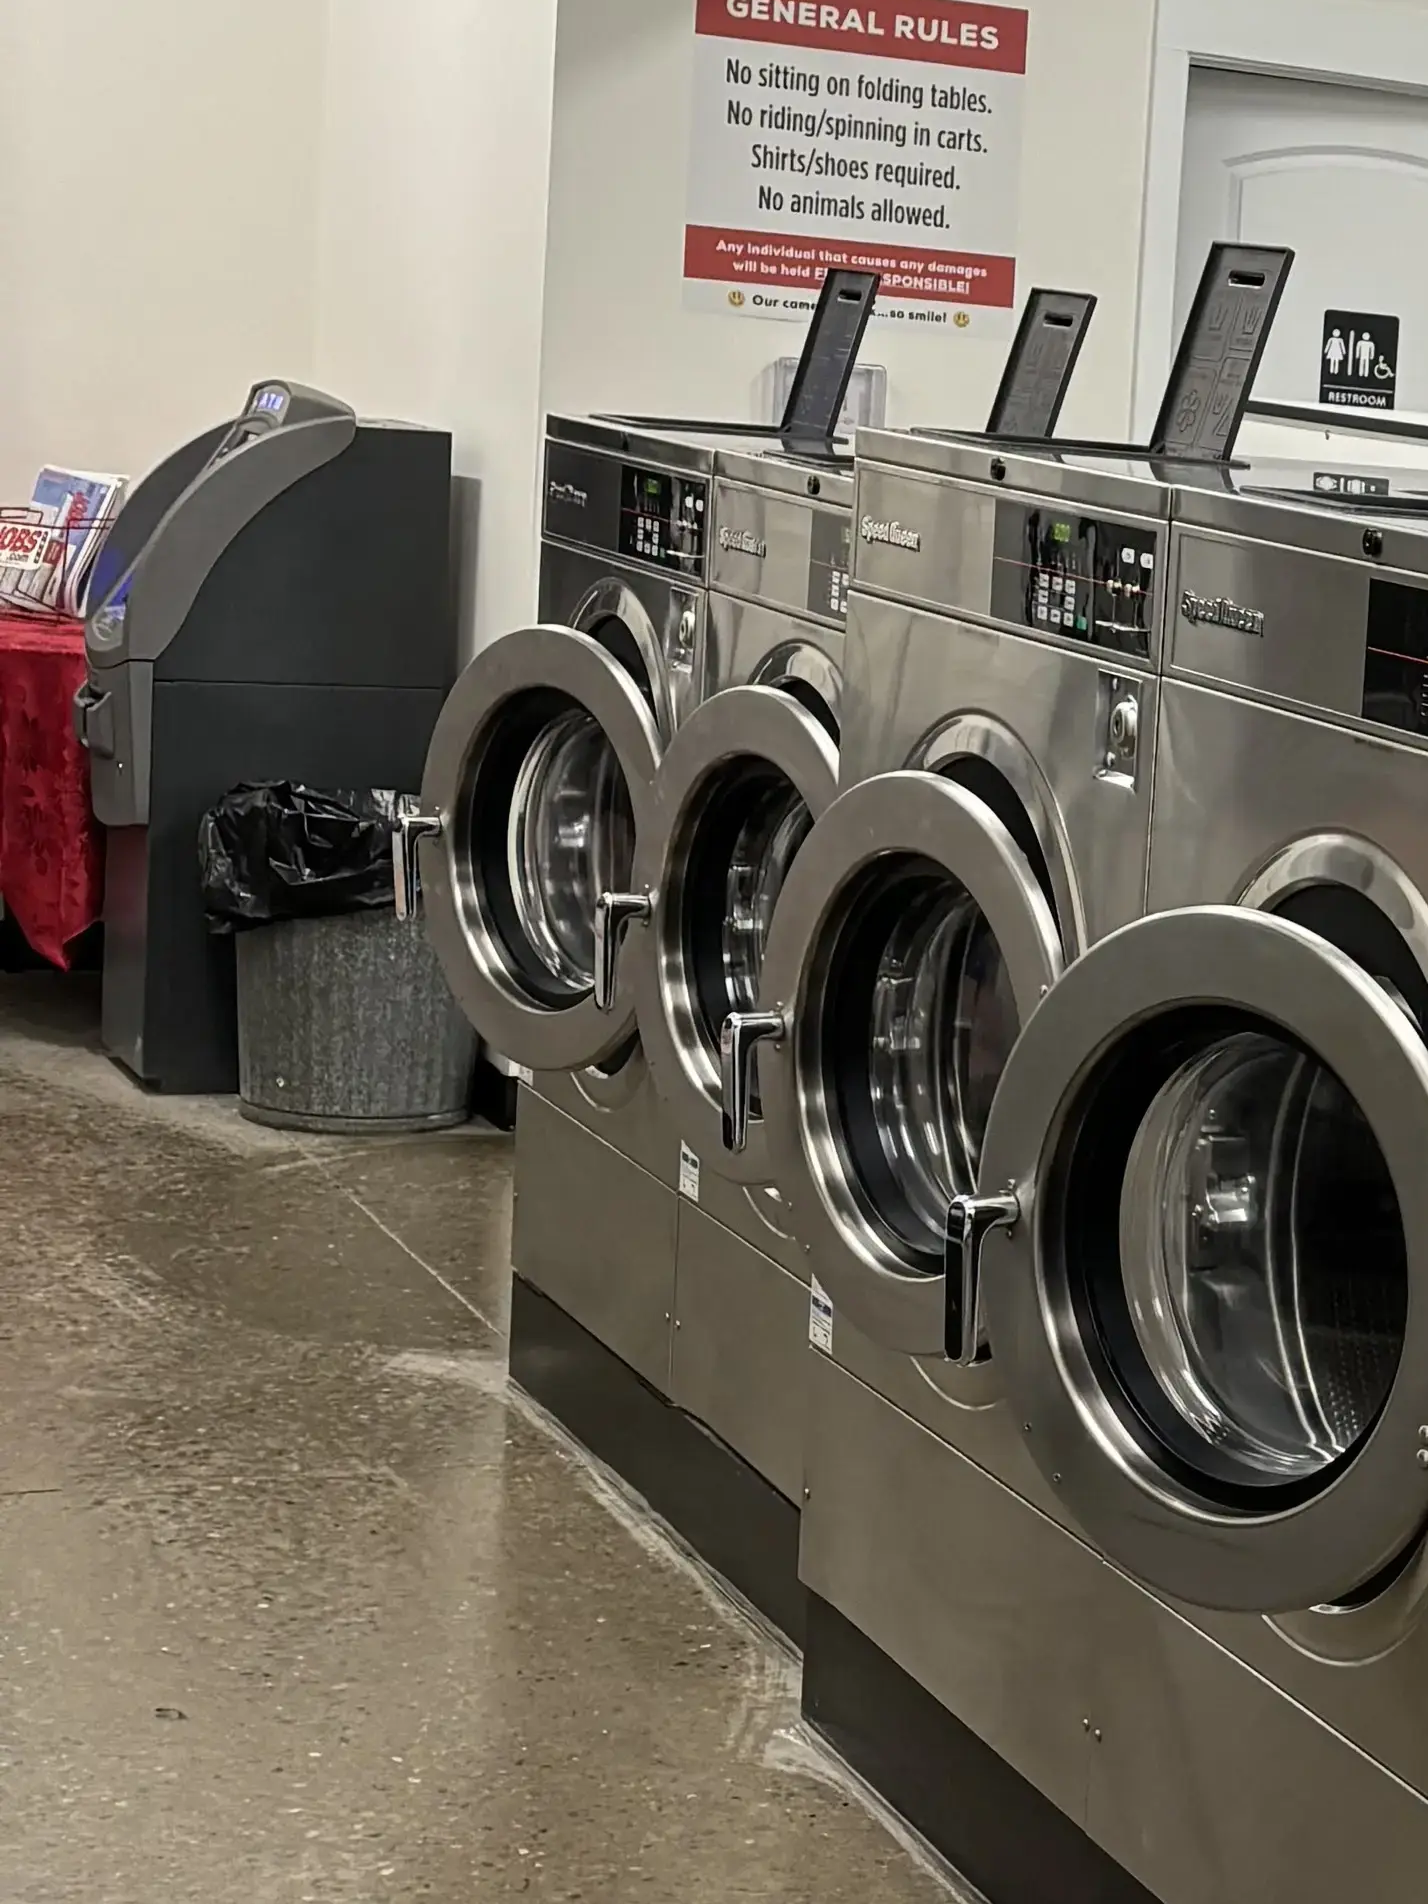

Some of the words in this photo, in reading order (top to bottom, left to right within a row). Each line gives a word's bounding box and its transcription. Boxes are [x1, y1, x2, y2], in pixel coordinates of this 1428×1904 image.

[895, 14, 999, 49] RULES
[726, 58, 751, 84] No
[758, 63, 820, 97] sitting
[827, 75, 850, 96] on
[857, 75, 924, 109] folding
[930, 83, 992, 114] tables.
[727, 100, 752, 126] No
[760, 104, 907, 147] riding/spinning
[913, 122, 930, 146] in
[937, 126, 988, 153] carts.
[751, 144, 869, 180] Shirts/shoes
[875, 160, 960, 190] required.
[758, 186, 783, 211] No
[790, 192, 865, 220] animals
[871, 198, 950, 229] allowed.
[716, 239, 744, 256] Any
[819, 250, 847, 264] that
[851, 255, 896, 269] causes
[900, 260, 923, 273] any
[928, 262, 987, 278] damages
[733, 260, 757, 273] will
[760, 262, 777, 275] be
[781, 264, 810, 277] held
[880, 272, 969, 295] SPONSIBLE!
[752, 295, 779, 308] Our
[908, 310, 947, 323] smile!
[1328, 391, 1386, 407] RESTROOM
